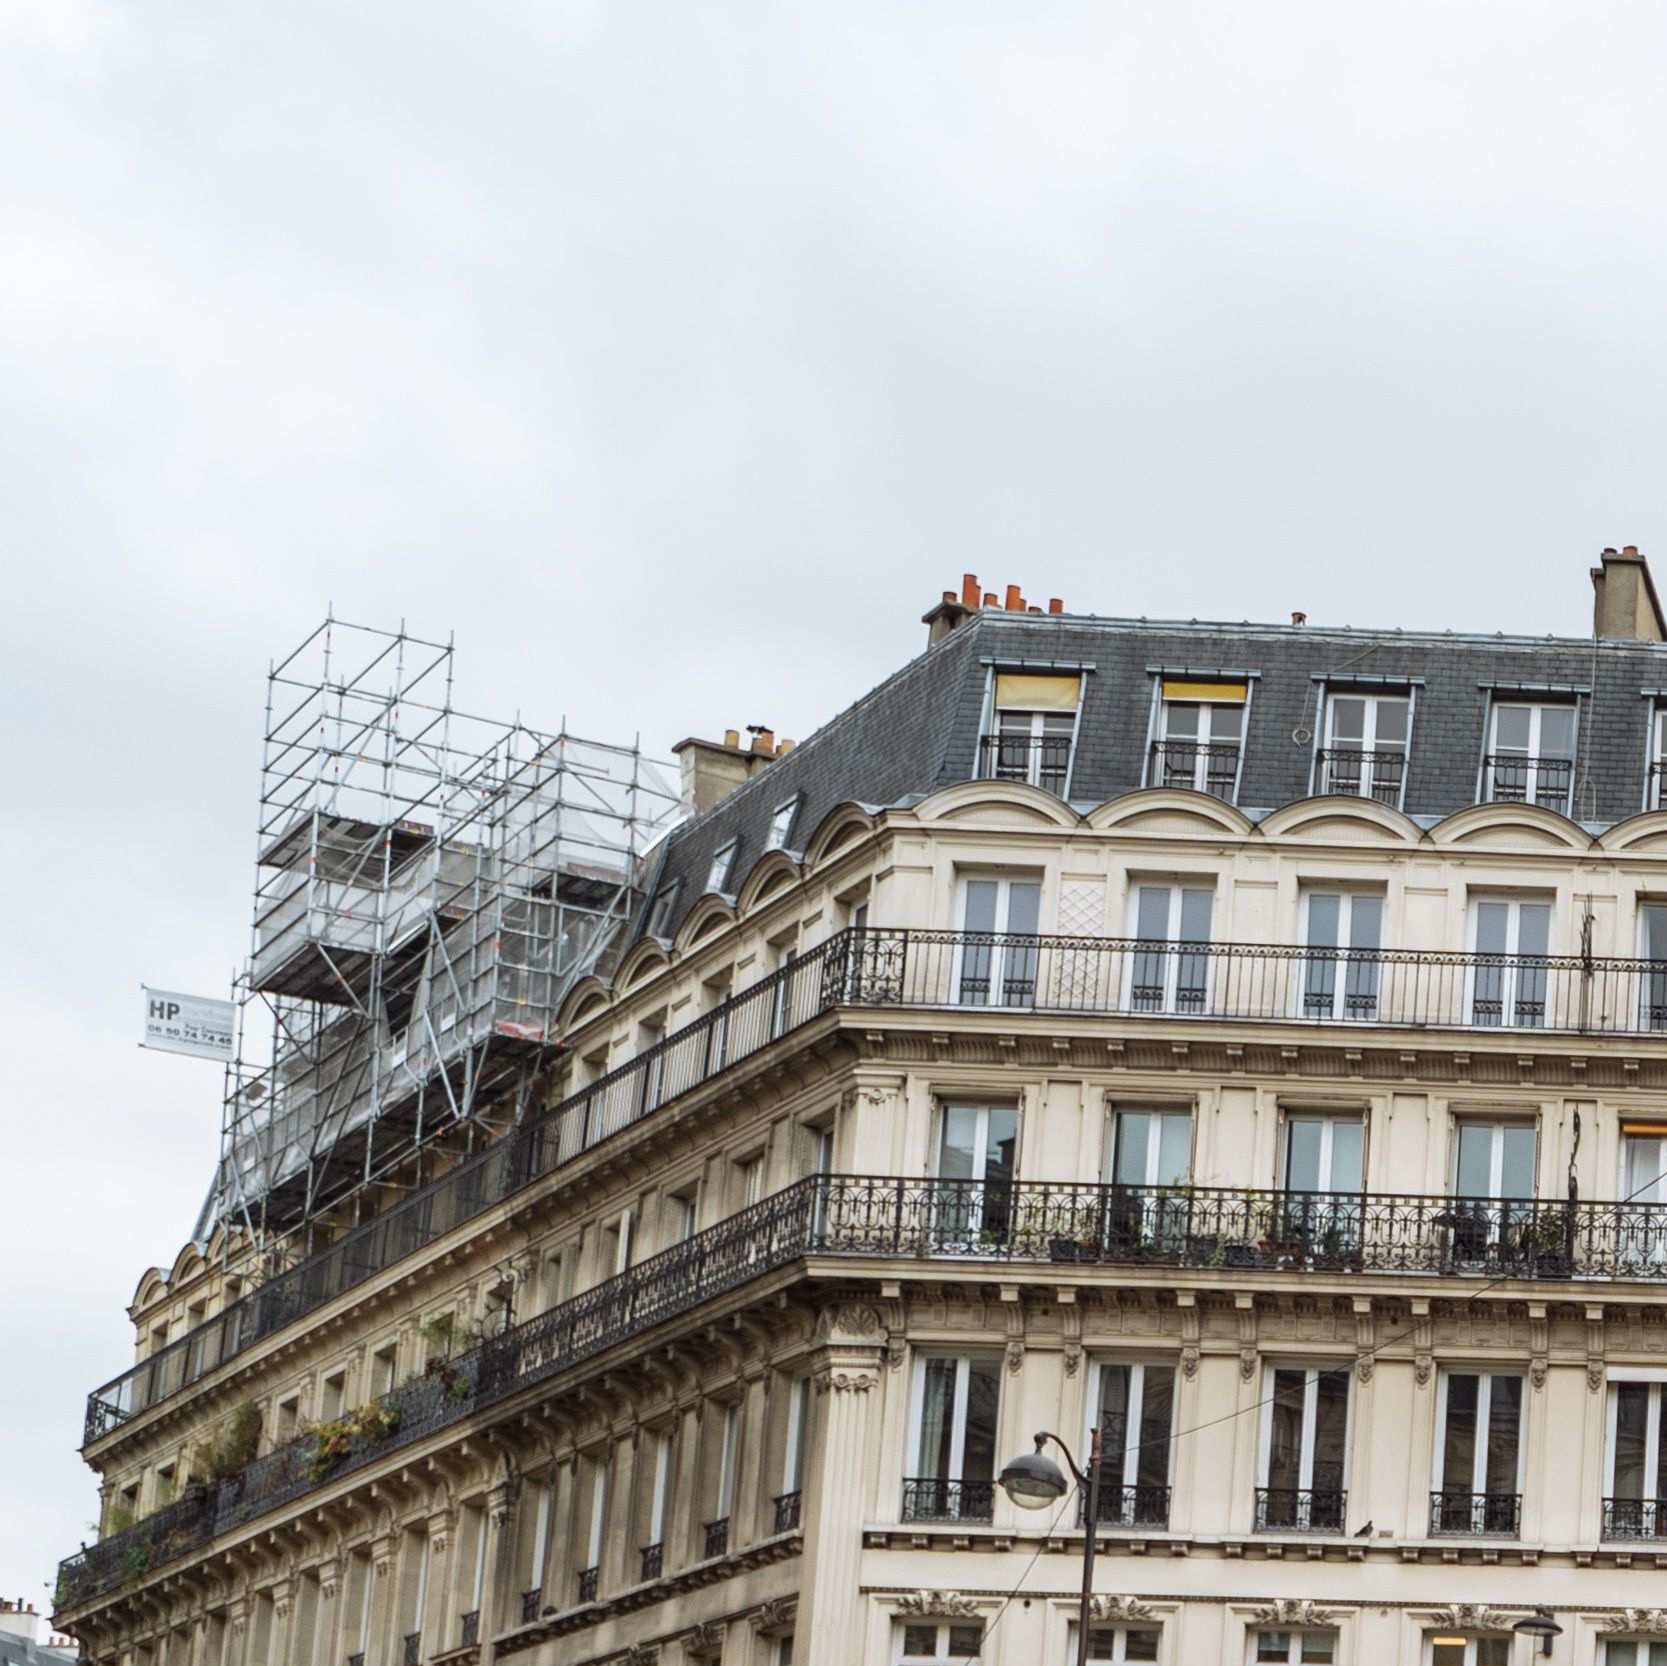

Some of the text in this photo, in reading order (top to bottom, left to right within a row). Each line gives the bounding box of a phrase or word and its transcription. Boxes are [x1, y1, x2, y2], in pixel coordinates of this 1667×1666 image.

[150, 1000, 180, 1020] HP
[184, 1030, 198, 1039] 74
[201, 1033, 215, 1042] 74
